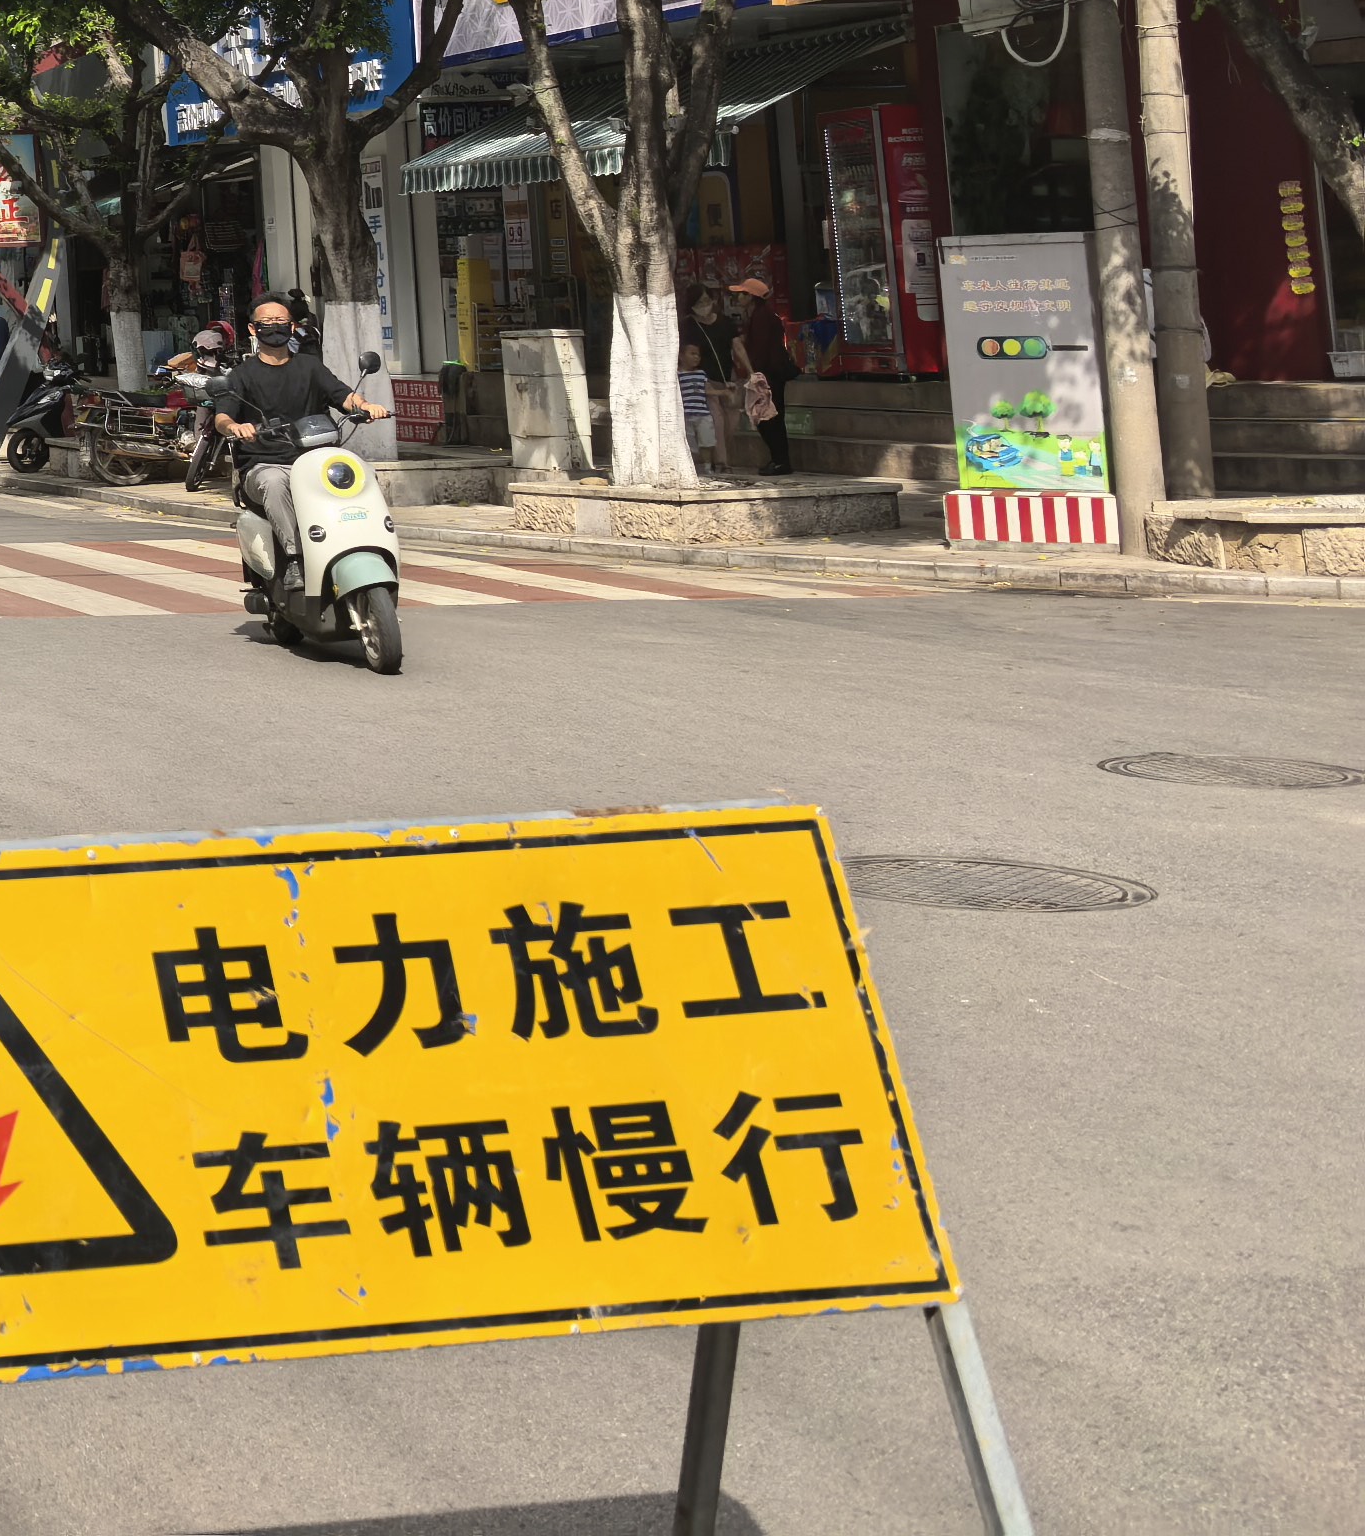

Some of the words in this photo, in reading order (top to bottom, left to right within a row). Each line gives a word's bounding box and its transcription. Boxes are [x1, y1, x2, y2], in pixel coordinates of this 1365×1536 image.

[509, 226, 523, 243] 9.9
[150, 899, 829, 1064] 电力施工
[192, 1091, 864, 1270] 车辆慢行
